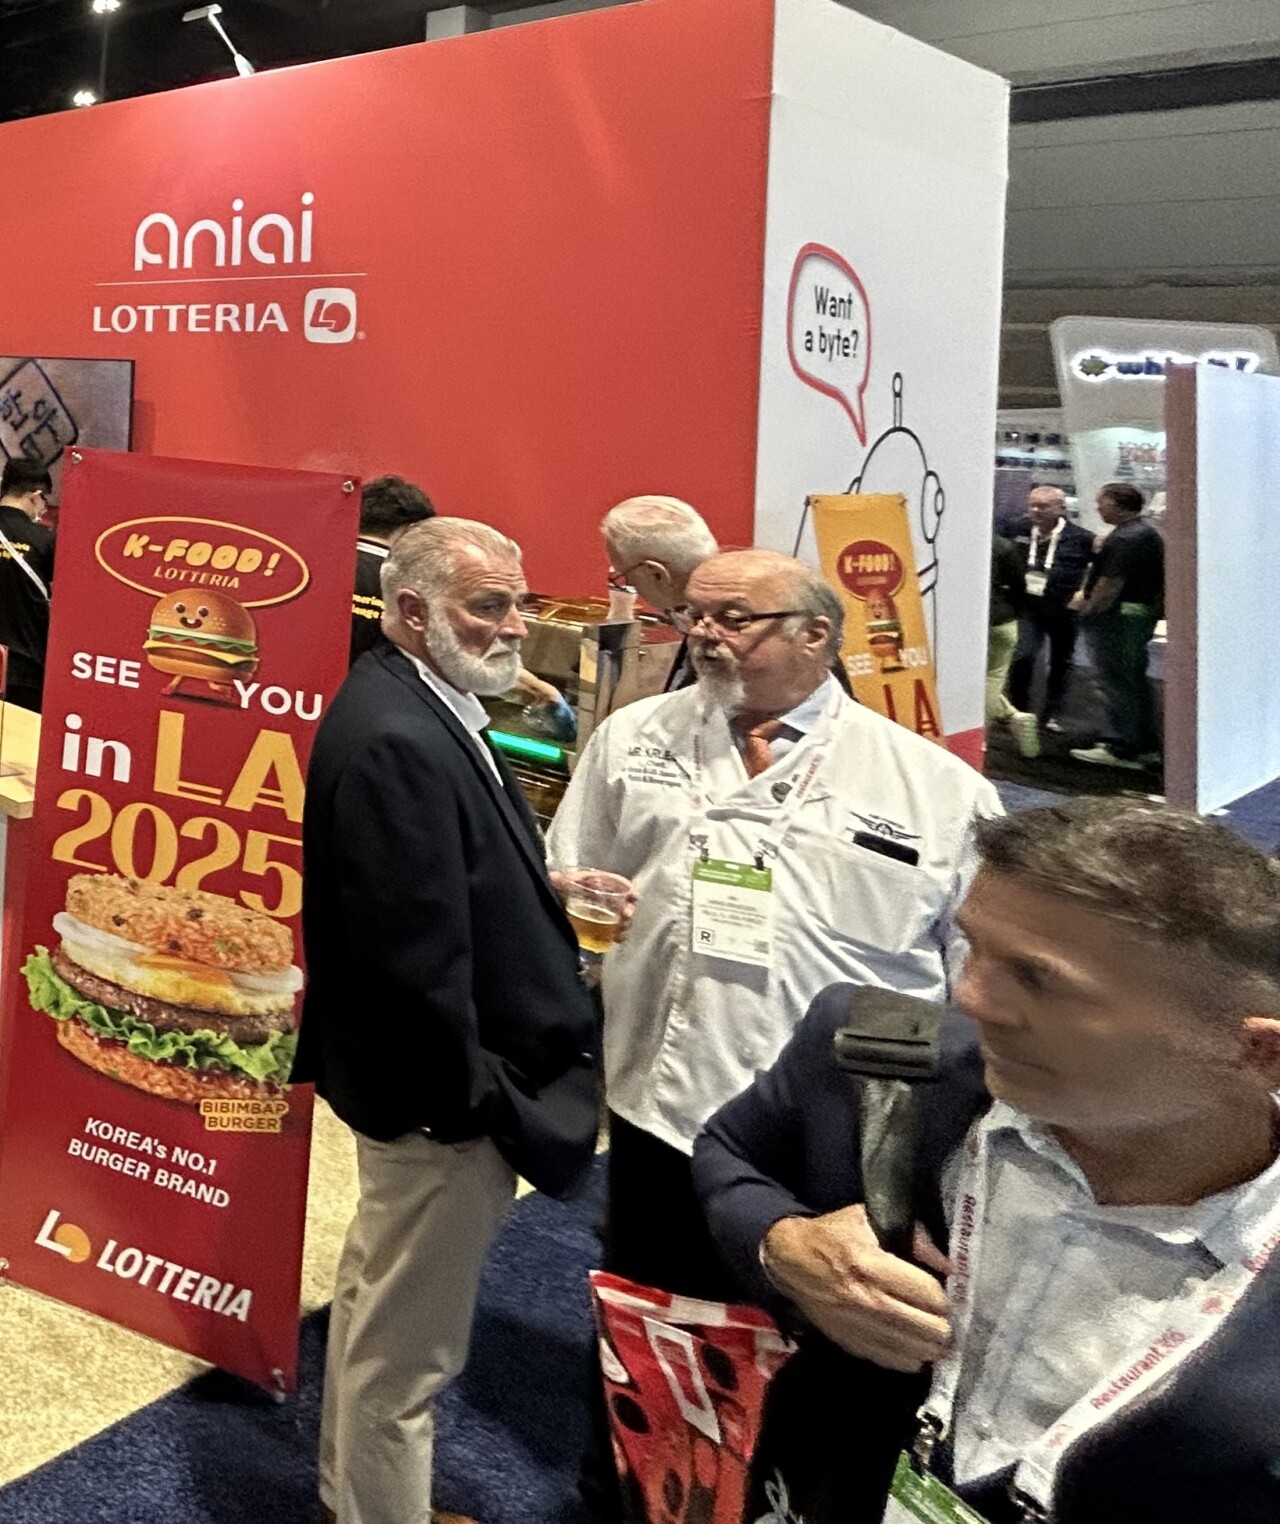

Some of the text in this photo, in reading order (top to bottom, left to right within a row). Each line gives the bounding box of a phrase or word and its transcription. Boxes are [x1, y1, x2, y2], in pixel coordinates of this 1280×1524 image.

[93, 302, 289, 333] LOTTERIA
[814, 285, 854, 320] Want
[804, 326, 859, 362] a byte?
[123, 533, 281, 577] K-FOOD!
[153, 566, 241, 589] LOTTERIA
[71, 652, 141, 689] SEE
[233, 679, 323, 721] YOU
[62, 710, 306, 823] in LA
[52, 788, 303, 918] 2025
[202, 1100, 286, 1116] BIBIMBAP
[207, 1116, 280, 1130] BURGER
[84, 1117, 218, 1176] KOREA's NO.1
[67, 1138, 230, 1208] BURGER BRAND
[96, 1239, 253, 1322] LOTTERIA
